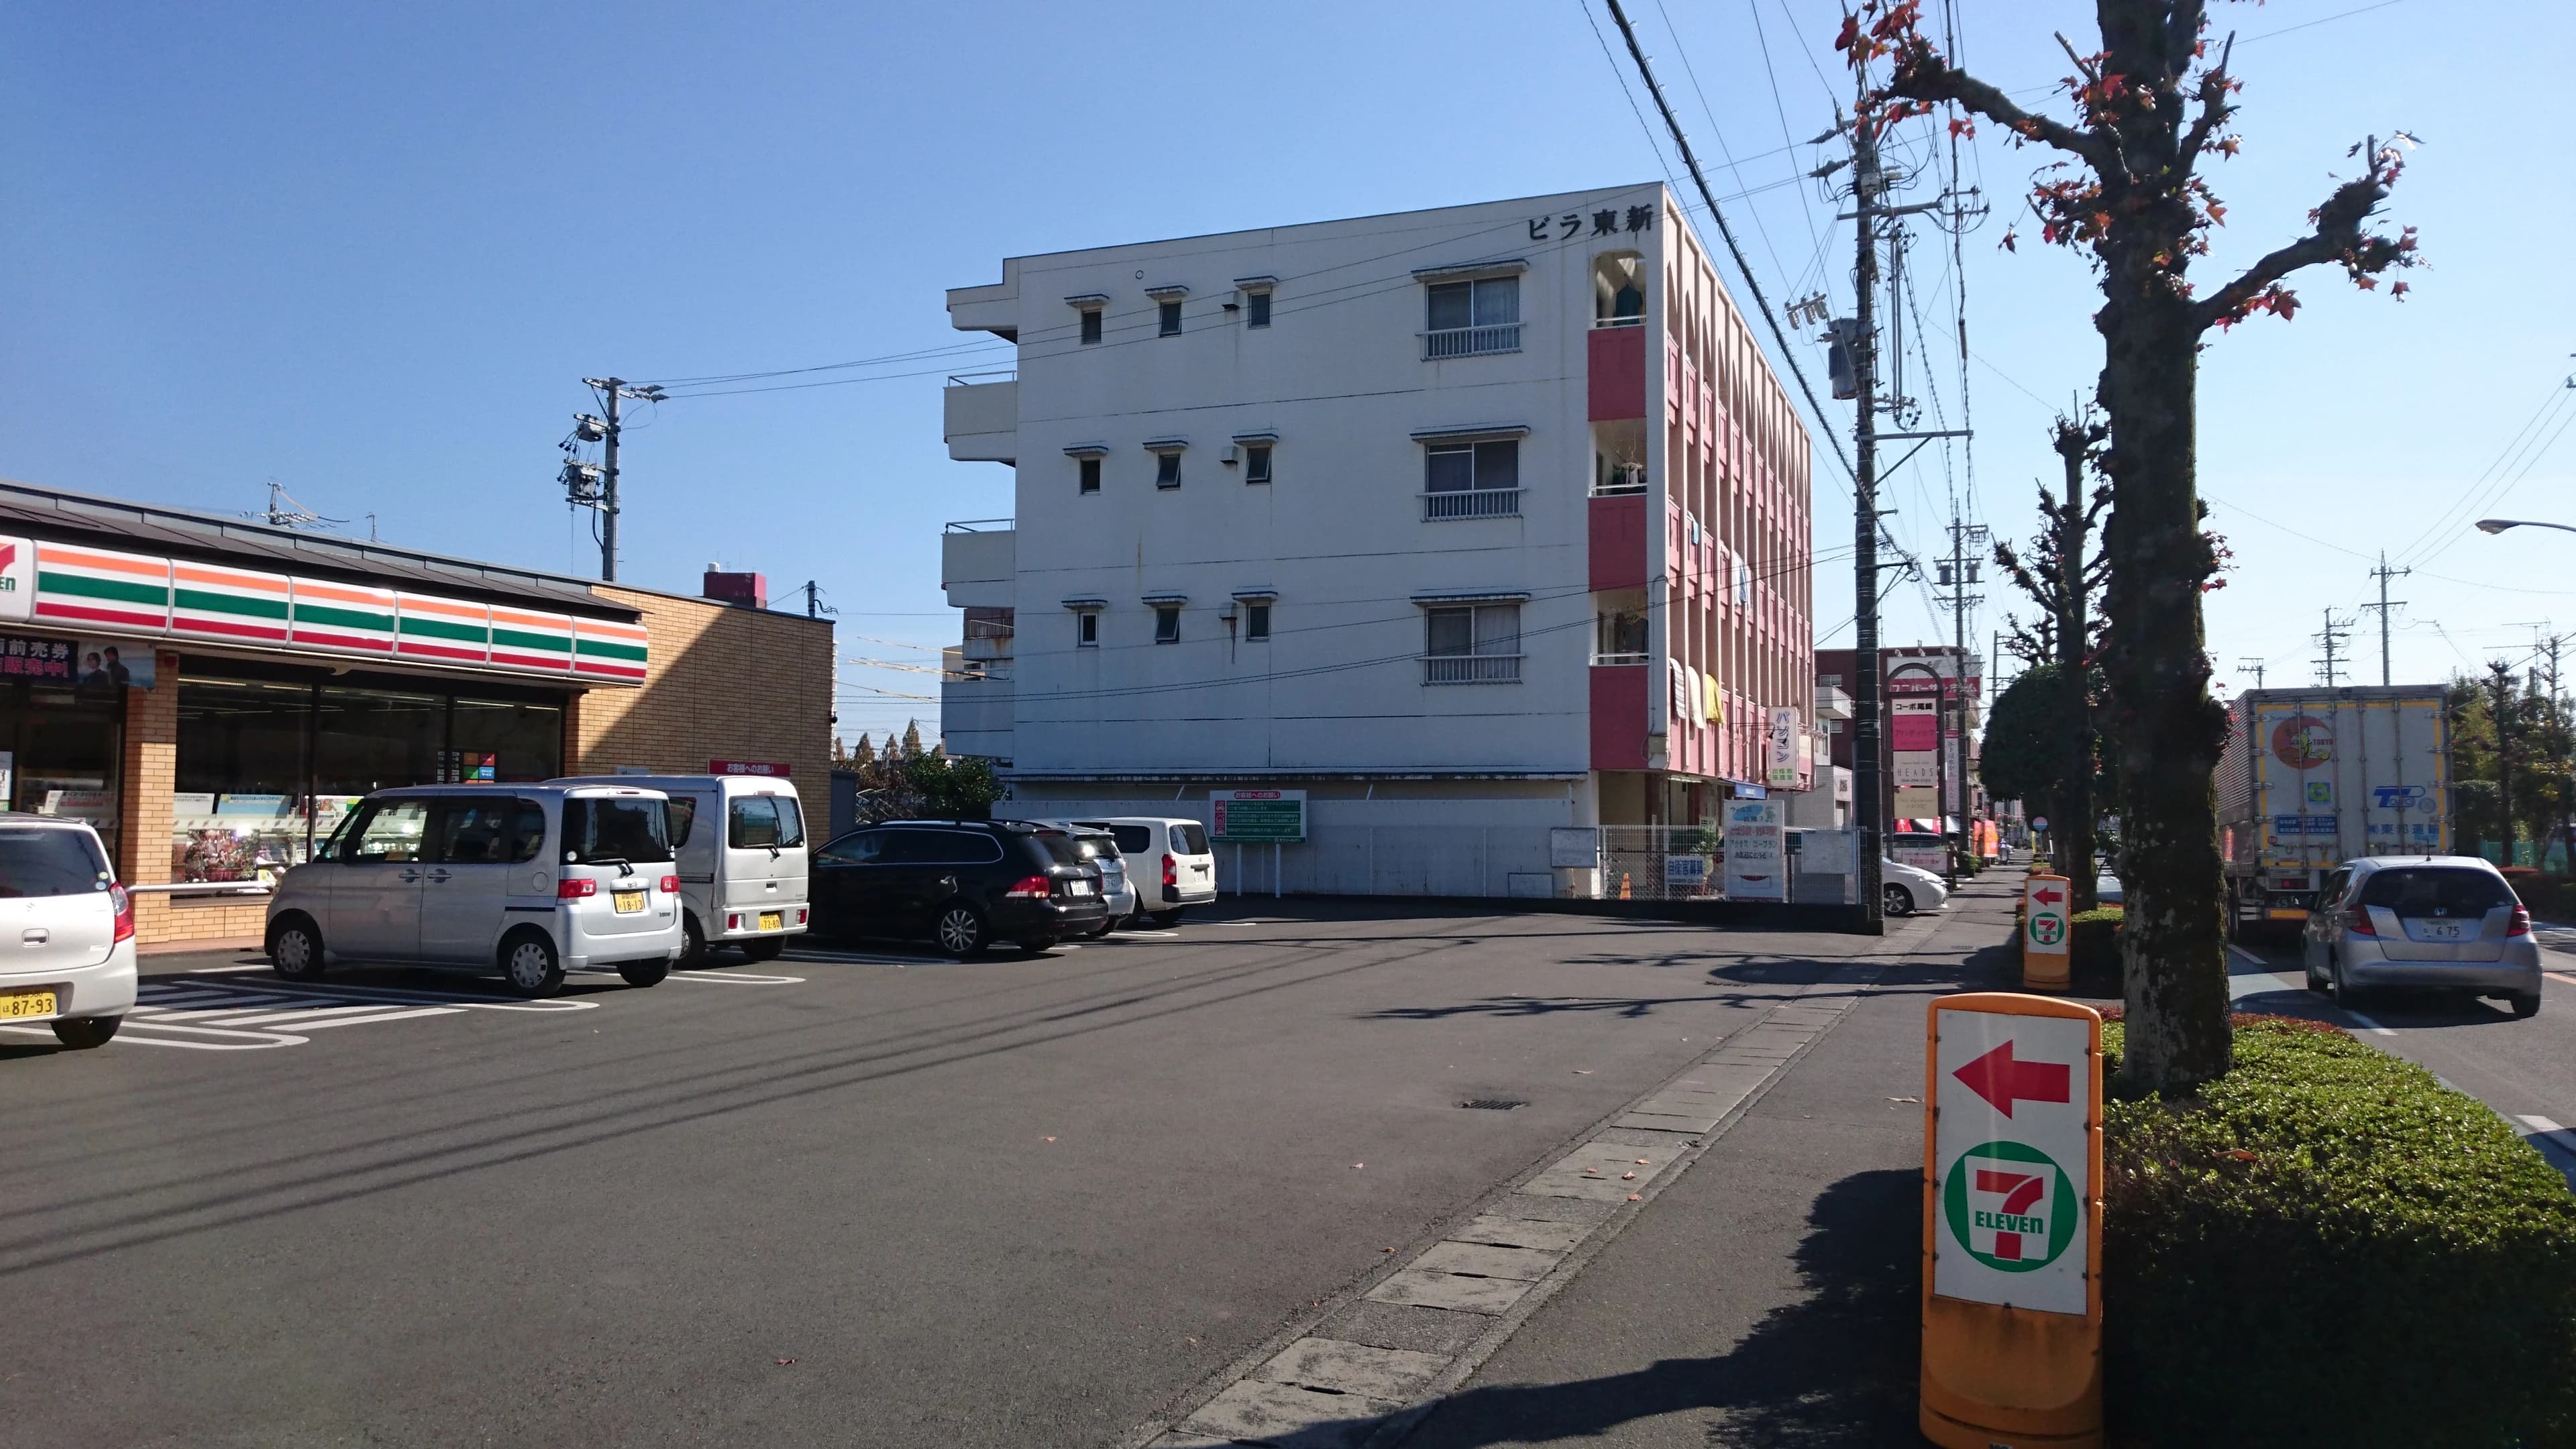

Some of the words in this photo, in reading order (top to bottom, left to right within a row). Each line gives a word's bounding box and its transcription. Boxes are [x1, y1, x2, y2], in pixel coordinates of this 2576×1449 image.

[1529, 203, 1654, 240] ビラ東新
[0, 639, 68, 659] 前売券
[1776, 712, 1790, 763] パソコン
[727, 763, 774, 773] お客様へのお願い
[1897, 768, 1933, 777] HEADS
[12, 998, 53, 1015] 87-93
[1976, 1169, 2044, 1262] 7
